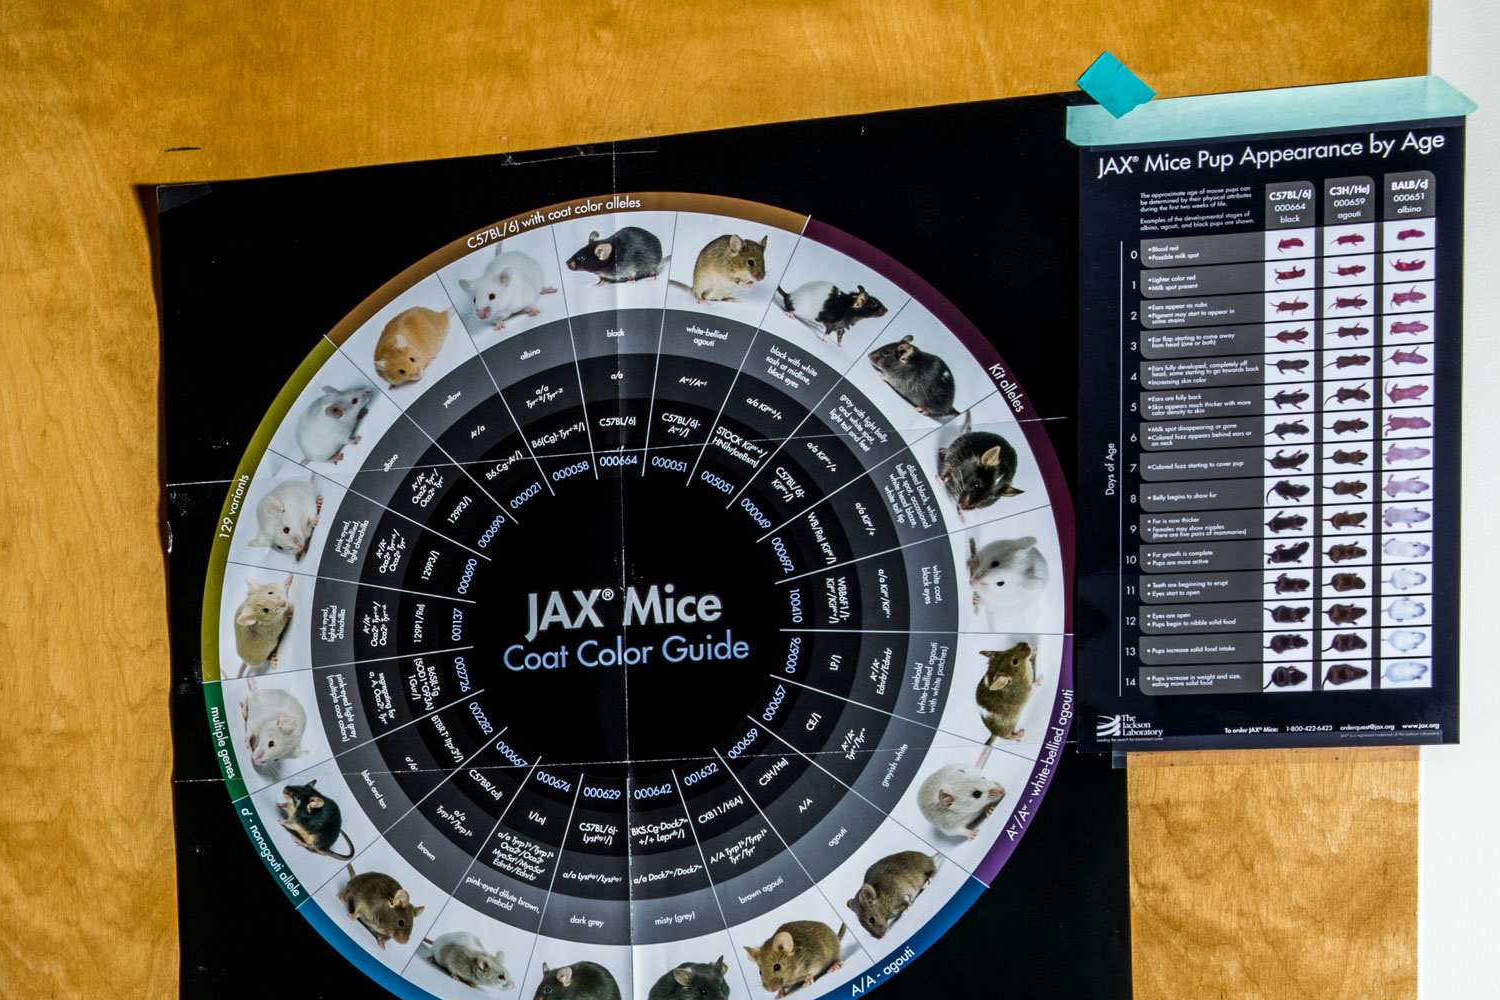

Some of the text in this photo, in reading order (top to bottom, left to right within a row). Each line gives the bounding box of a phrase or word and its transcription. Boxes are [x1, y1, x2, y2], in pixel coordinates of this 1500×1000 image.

[1144, 153, 1191, 173] Mice
[1198, 150, 1234, 172] Pup
[1239, 141, 1363, 169] Appearance
[1369, 132, 1396, 158] by
[1400, 131, 1445, 154] Age
[1329, 183, 1370, 196] C3H/HeJ
[1391, 178, 1428, 191] BALB/cJ
[1269, 188, 1312, 202] C57BL/6J
[1333, 197, 1366, 208] 000659
[1393, 193, 1425, 203] 000651
[1274, 202, 1306, 213] 000664
[1337, 209, 1362, 221] agouti
[1397, 204, 1422, 215] albino
[467, 196, 641, 249] C57BL/6J with coat color alleles
[1279, 214, 1301, 224] black
[1131, 251, 1137, 259] 0
[1131, 311, 1137, 320] 2
[1131, 342, 1137, 350] 3
[988, 363, 1024, 413] Kit alleles
[1131, 403, 1136, 411] 5
[1131, 434, 1137, 442] 6
[600, 455, 637, 466] 000664
[652, 456, 687, 472] 000051
[1131, 464, 1137, 472] 7
[553, 461, 589, 481] 000058
[1105, 442, 1117, 496] Days of Age
[701, 471, 734, 494] 005051
[510, 482, 542, 508] 000021
[1131, 495, 1136, 503] 8
[219, 474, 249, 538] 129 variants
[741, 498, 771, 528] 000049
[478, 515, 505, 547] 000690
[1130, 525, 1136, 533] 9
[772, 537, 794, 573] 000692
[1126, 556, 1136, 564] 10
[458, 559, 477, 594] 000690
[1127, 586, 1134, 594] 11
[620, 581, 721, 628] Mice
[790, 589, 802, 623] 100410
[452, 608, 462, 641] 001137
[1126, 617, 1136, 625] 12
[504, 629, 749, 671] Coat Color Guide
[785, 638, 801, 673] 000676
[1126, 647, 1135, 656] 13
[454, 657, 470, 692] 002726
[1126, 678, 1135, 686] 14
[763, 685, 786, 721] 000657
[469, 702, 493, 735] 002282
[1122, 721, 1151, 730] Jackson
[1122, 729, 1163, 737] Laboratory
[1285, 724, 1333, 732] 1-800-422-6423
[1339, 723, 1395, 732] orderquest@jax.org
[1402, 722, 1440, 731] www.jax.org
[210, 706, 236, 780] multiple genes
[728, 728, 758, 759] 000659
[1031, 726, 1065, 797] white-bellied
[1058, 689, 1074, 726] agouti
[494, 741, 528, 768] 000667
[537, 771, 571, 792] 000674
[684, 763, 718, 786] 001632
[584, 787, 621, 799] 000629
[634, 784, 672, 799] 000642
[249, 824, 285, 873] nonagouti
[279, 871, 301, 897] allele
[852, 975, 877, 997] A/A
[883, 945, 915, 973] agouti
